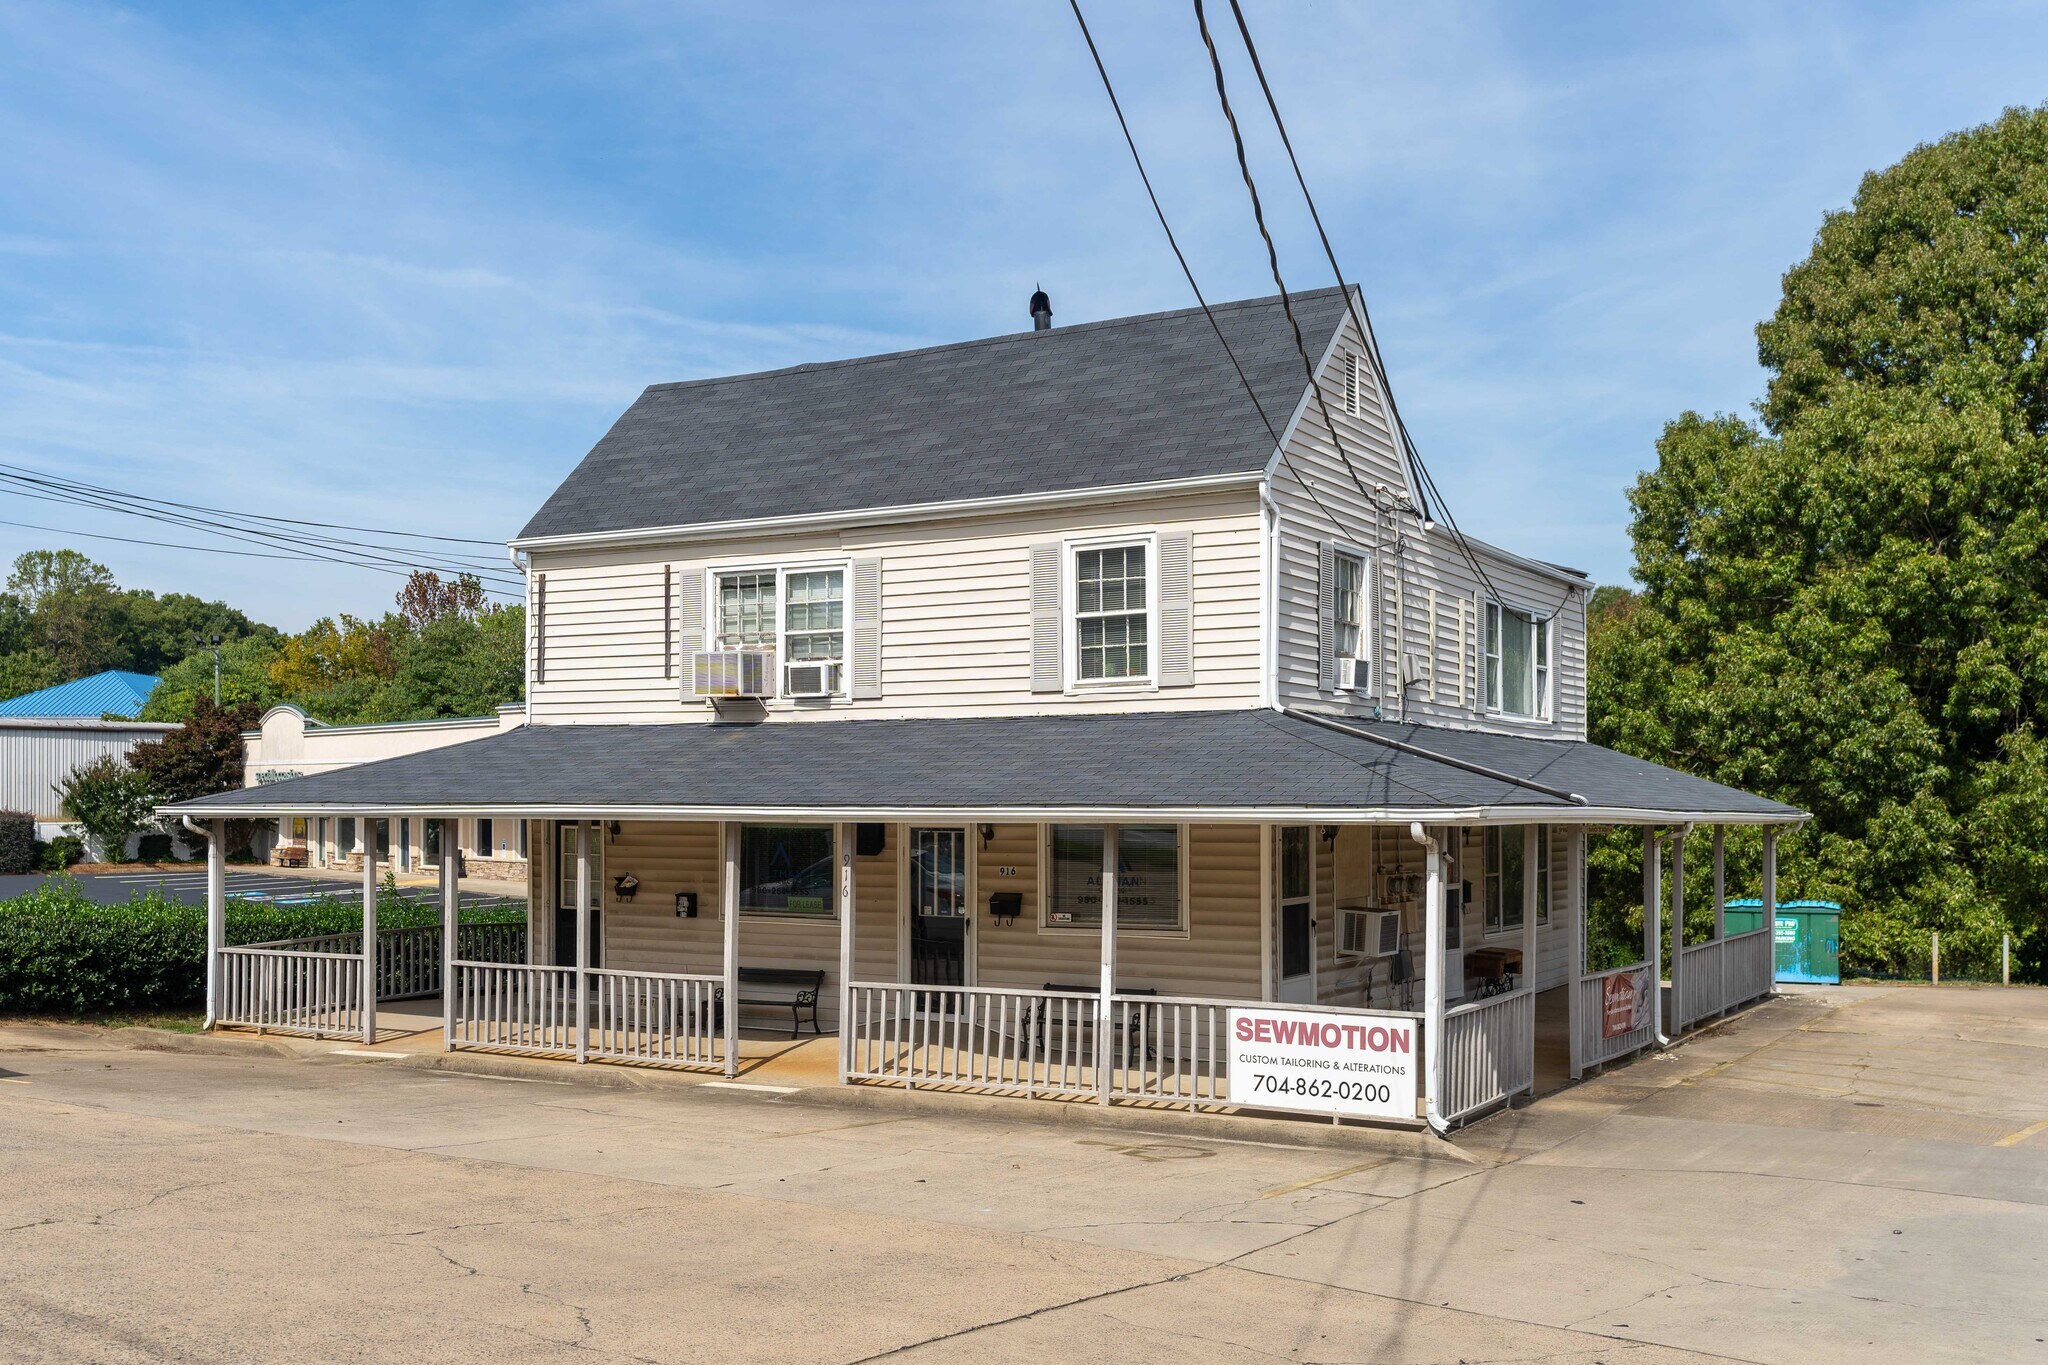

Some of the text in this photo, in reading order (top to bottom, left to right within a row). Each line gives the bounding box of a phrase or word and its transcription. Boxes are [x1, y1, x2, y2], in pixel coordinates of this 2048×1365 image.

[1000, 866, 1016, 876] 916
[789, 899, 822, 909] FOR LEASE
[1235, 1016, 1410, 1054] SEWMOTION
[1239, 1053, 1406, 1075] CUSTOM TAILORING & ALTERATIONS
[1253, 1074, 1390, 1103] 704-862-0200
